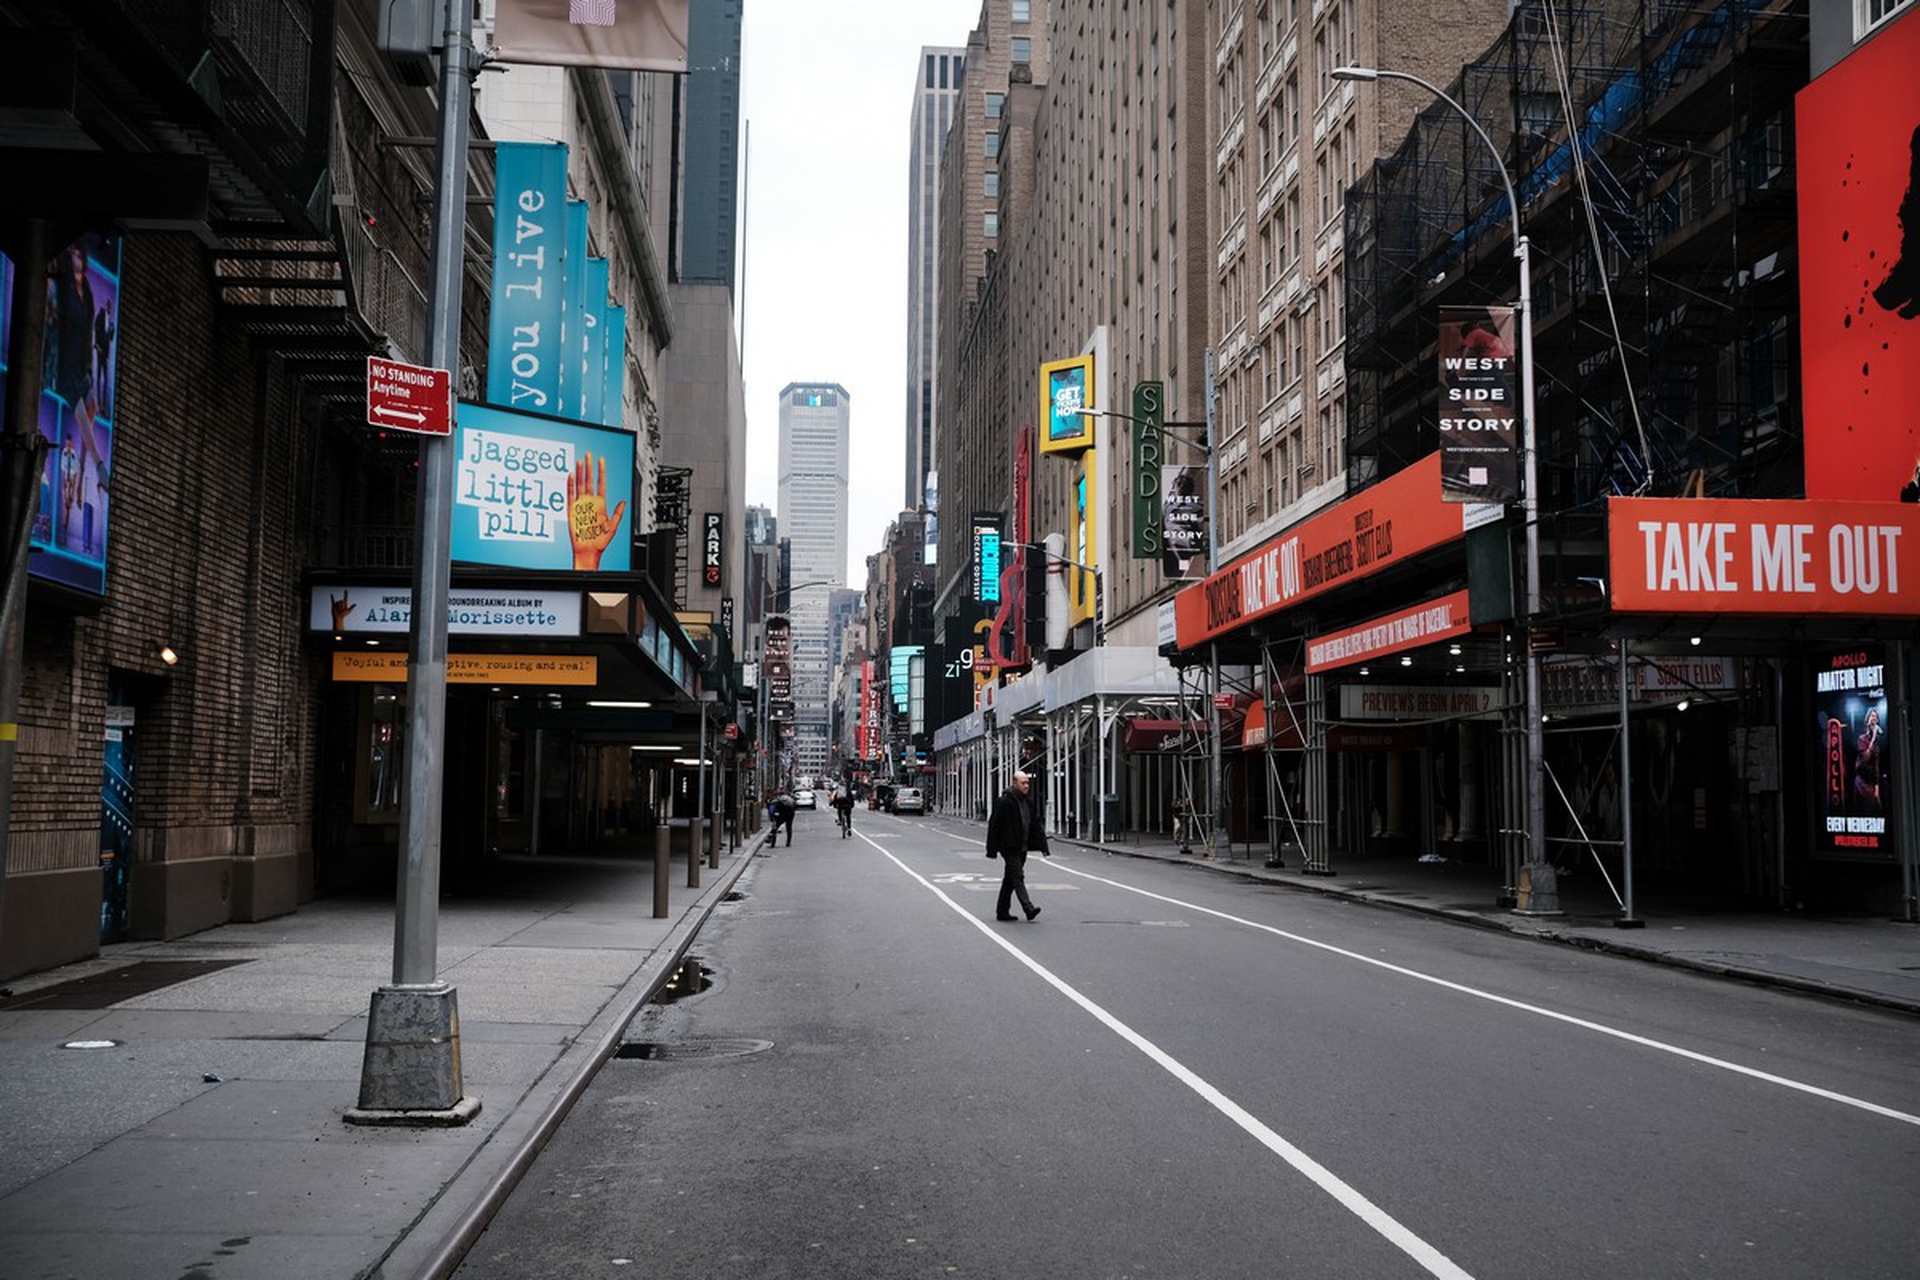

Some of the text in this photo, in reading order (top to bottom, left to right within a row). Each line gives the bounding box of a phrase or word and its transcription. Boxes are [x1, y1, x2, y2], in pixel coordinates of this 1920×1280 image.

[506, 189, 548, 407] you live
[1445, 358, 1508, 371] WEST
[373, 365, 435, 388] NO STANDING
[373, 380, 411, 399] Anytime
[1056, 386, 1082, 401] GET
[1448, 388, 1505, 401] SIDE
[1439, 418, 1515, 431] STORY
[470, 432, 569, 474] jagged
[463, 469, 565, 513] little
[574, 502, 596, 515] OUR
[1164, 496, 1199, 504] WEST
[483, 508, 550, 538] pill
[575, 512, 599, 528] NEW
[1168, 513, 1198, 521] SIDE
[575, 526, 609, 542] MUSICAL
[707, 515, 720, 566] PARK
[1162, 531, 1203, 540] STORY
[1638, 521, 1902, 594] TAKE ME OUT
[1240, 555, 1263, 617] TAKE
[1263, 545, 1280, 608] ME
[1280, 536, 1300, 599] OUT
[508, 599, 533, 608] ALBUM
[534, 599, 543, 608] BY
[487, 660, 533, 672] rousing
[536, 660, 556, 670] and
[1832, 652, 1867, 667] APOLLO
[1656, 663, 1690, 686] SCOTT
[1694, 663, 1722, 686] ELLIS
[1817, 664, 1885, 693] AMATEUR NIGHT
[1362, 692, 1415, 712] PREVIEWS
[1417, 691, 1448, 712] BEGIN
[1451, 693, 1480, 712] APRIL
[1829, 724, 1840, 806] APOLLO
[1827, 817, 1886, 834] EVERY WEDNESDAY
